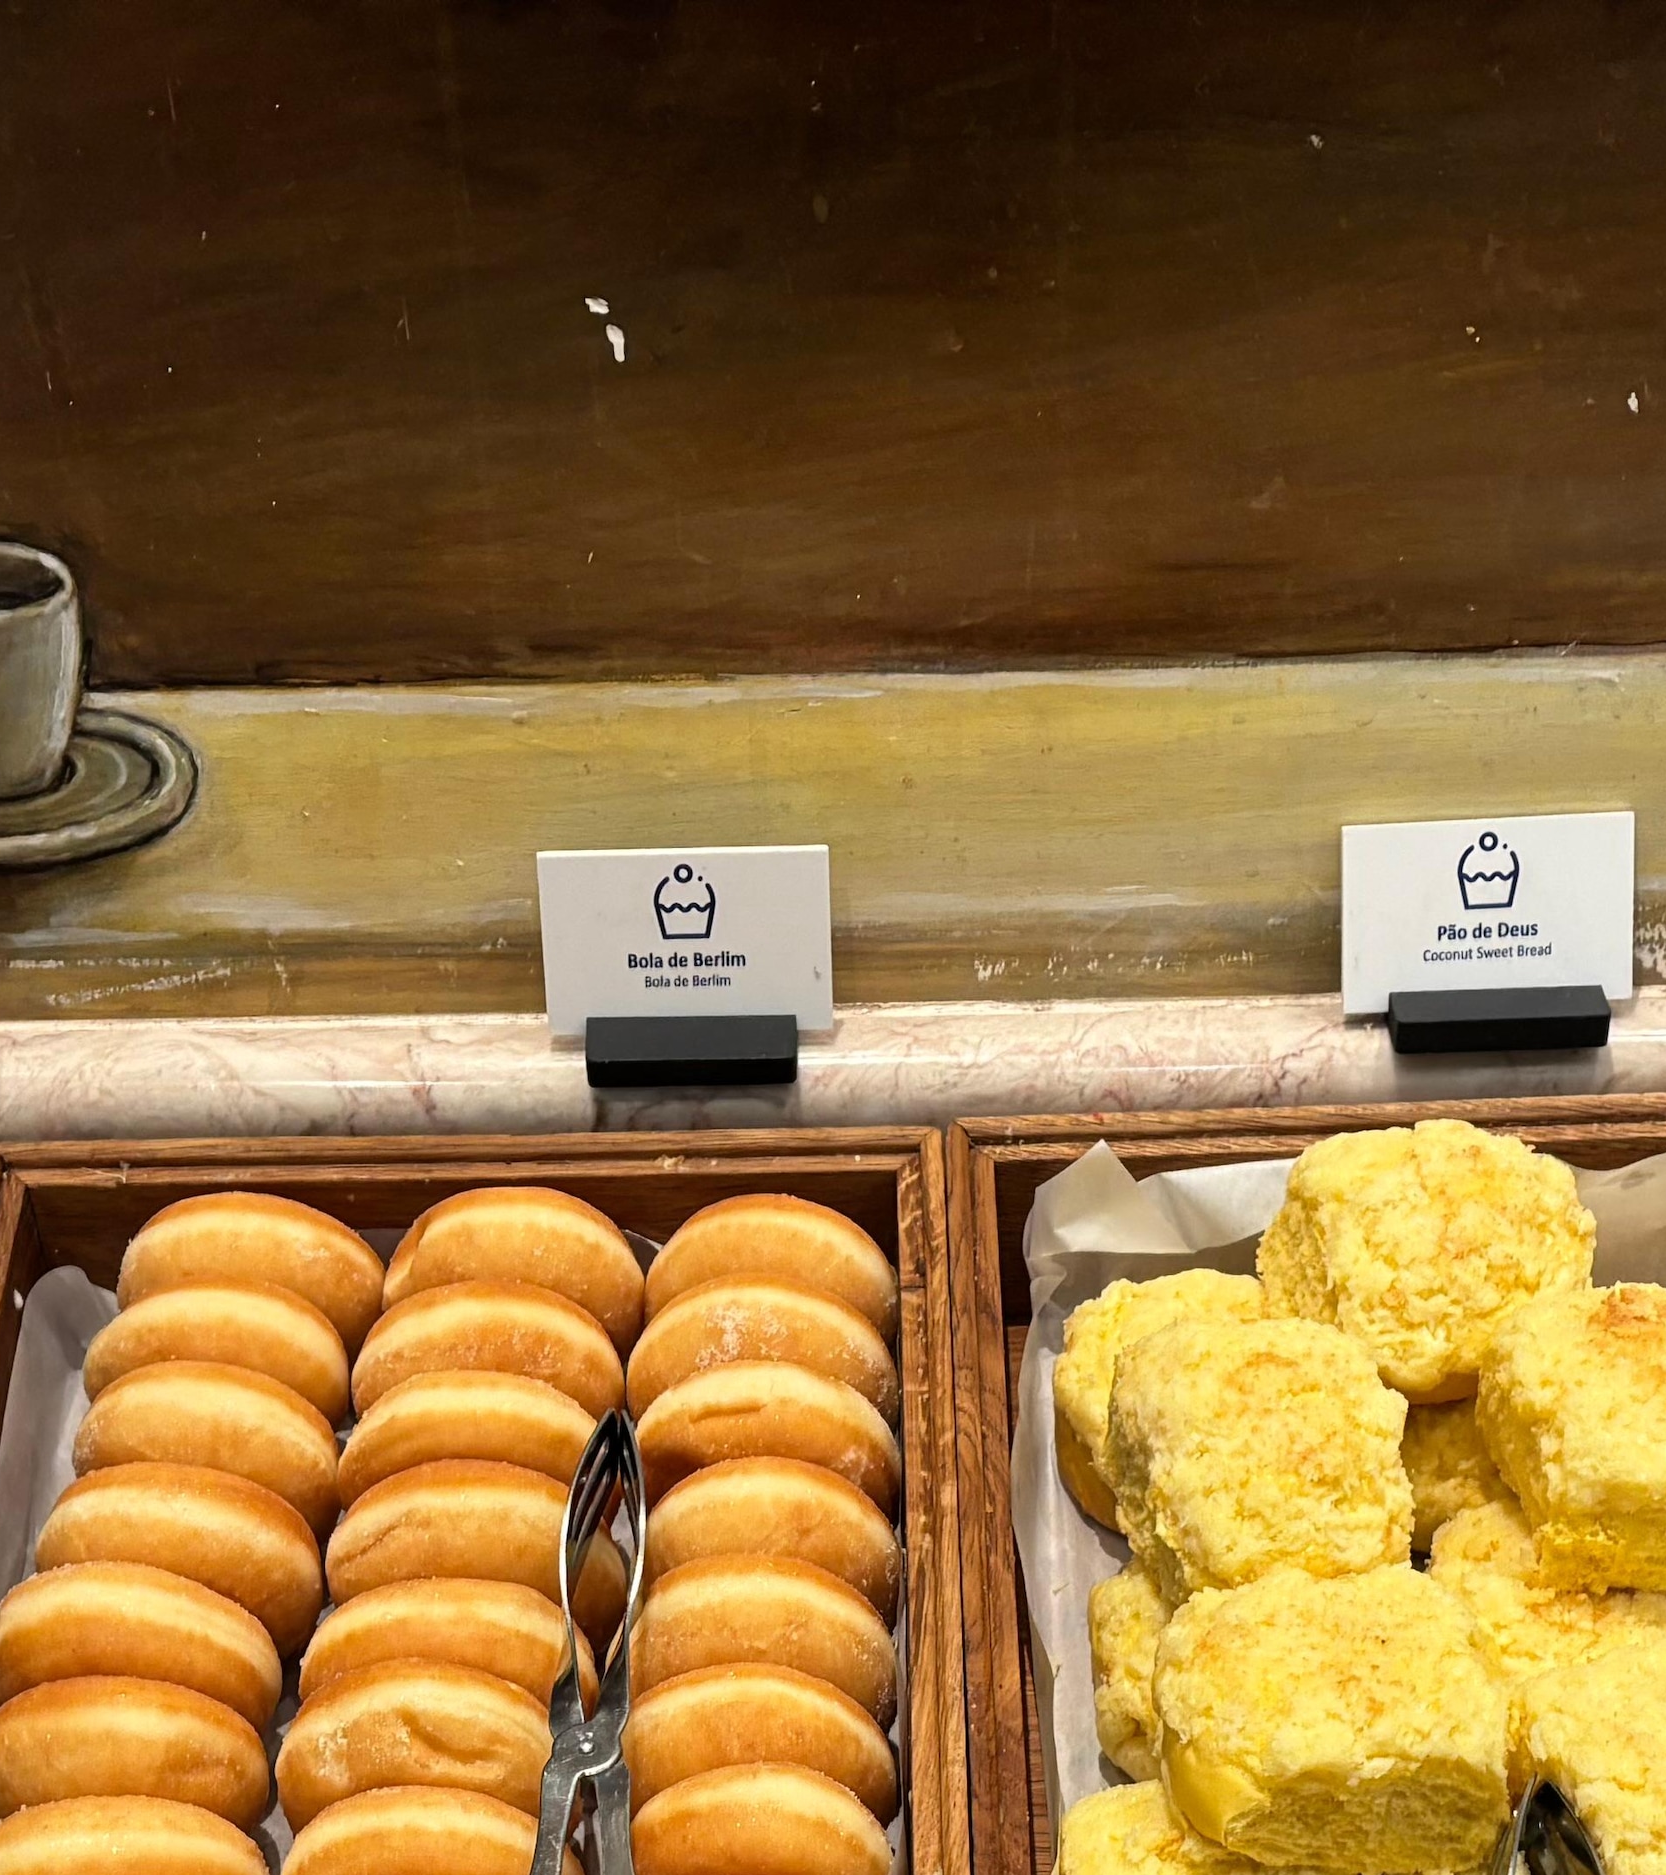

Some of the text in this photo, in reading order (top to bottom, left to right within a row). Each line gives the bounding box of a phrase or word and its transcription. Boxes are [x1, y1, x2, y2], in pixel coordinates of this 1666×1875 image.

[1437, 922, 1539, 942] Pão de Deus
[627, 950, 746, 969] Bola de Berlim
[1422, 941, 1552, 962] Coconut Sweet Bread
[644, 974, 731, 989] Bola de Berlim
